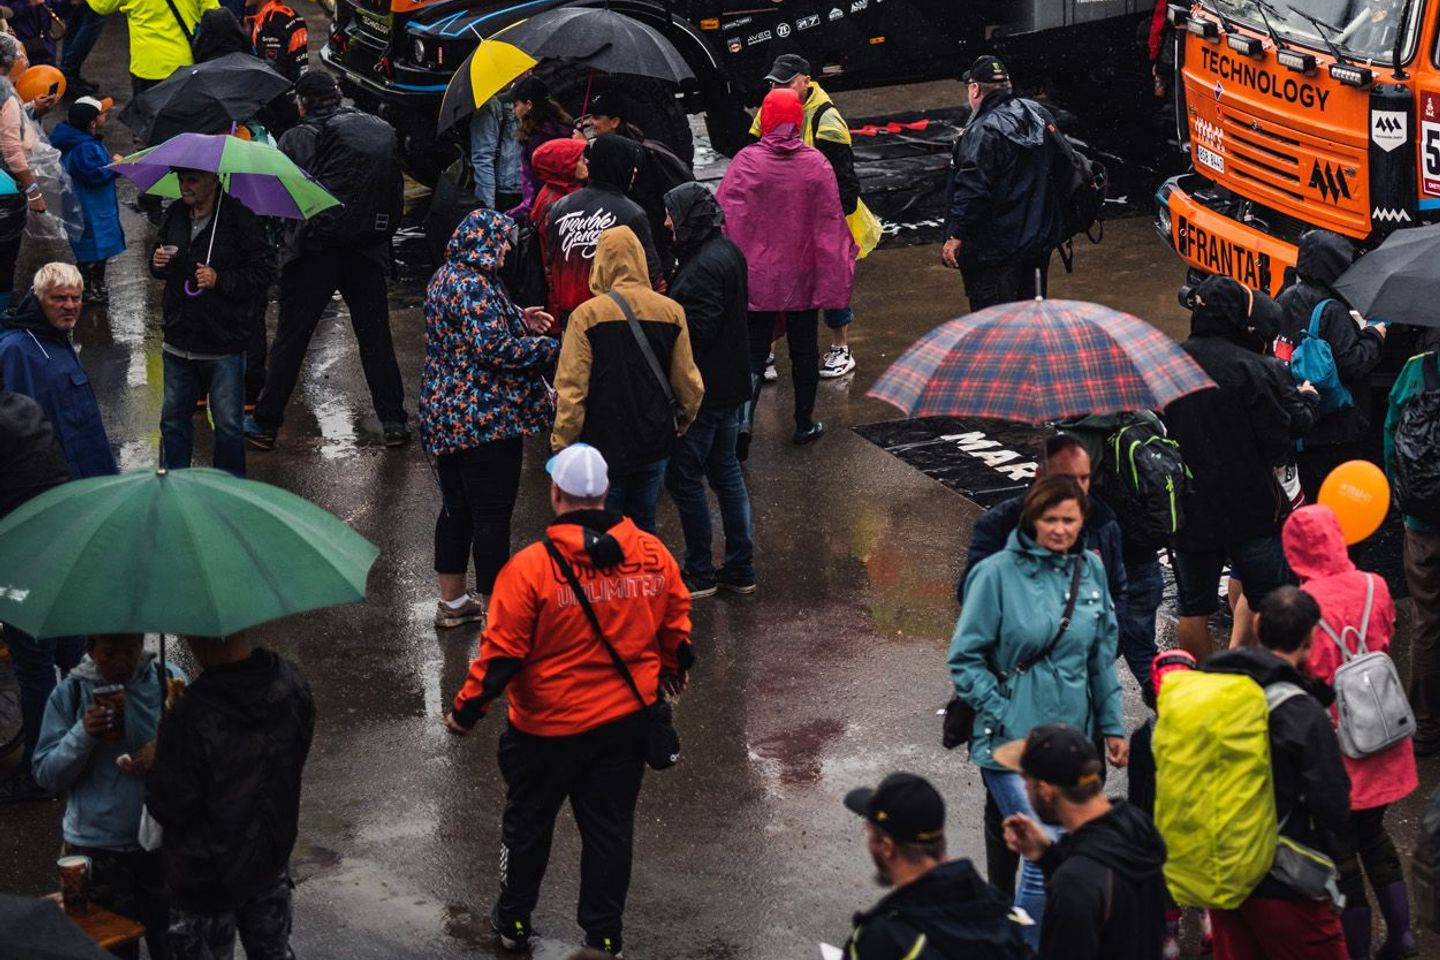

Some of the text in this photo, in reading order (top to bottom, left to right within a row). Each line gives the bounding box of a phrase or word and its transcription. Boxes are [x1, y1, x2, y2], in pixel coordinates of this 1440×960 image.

[1200, 47, 1330, 111] TECHNOLOGY
[555, 207, 617, 236] Trouble
[1187, 223, 1258, 288] FRANTA
